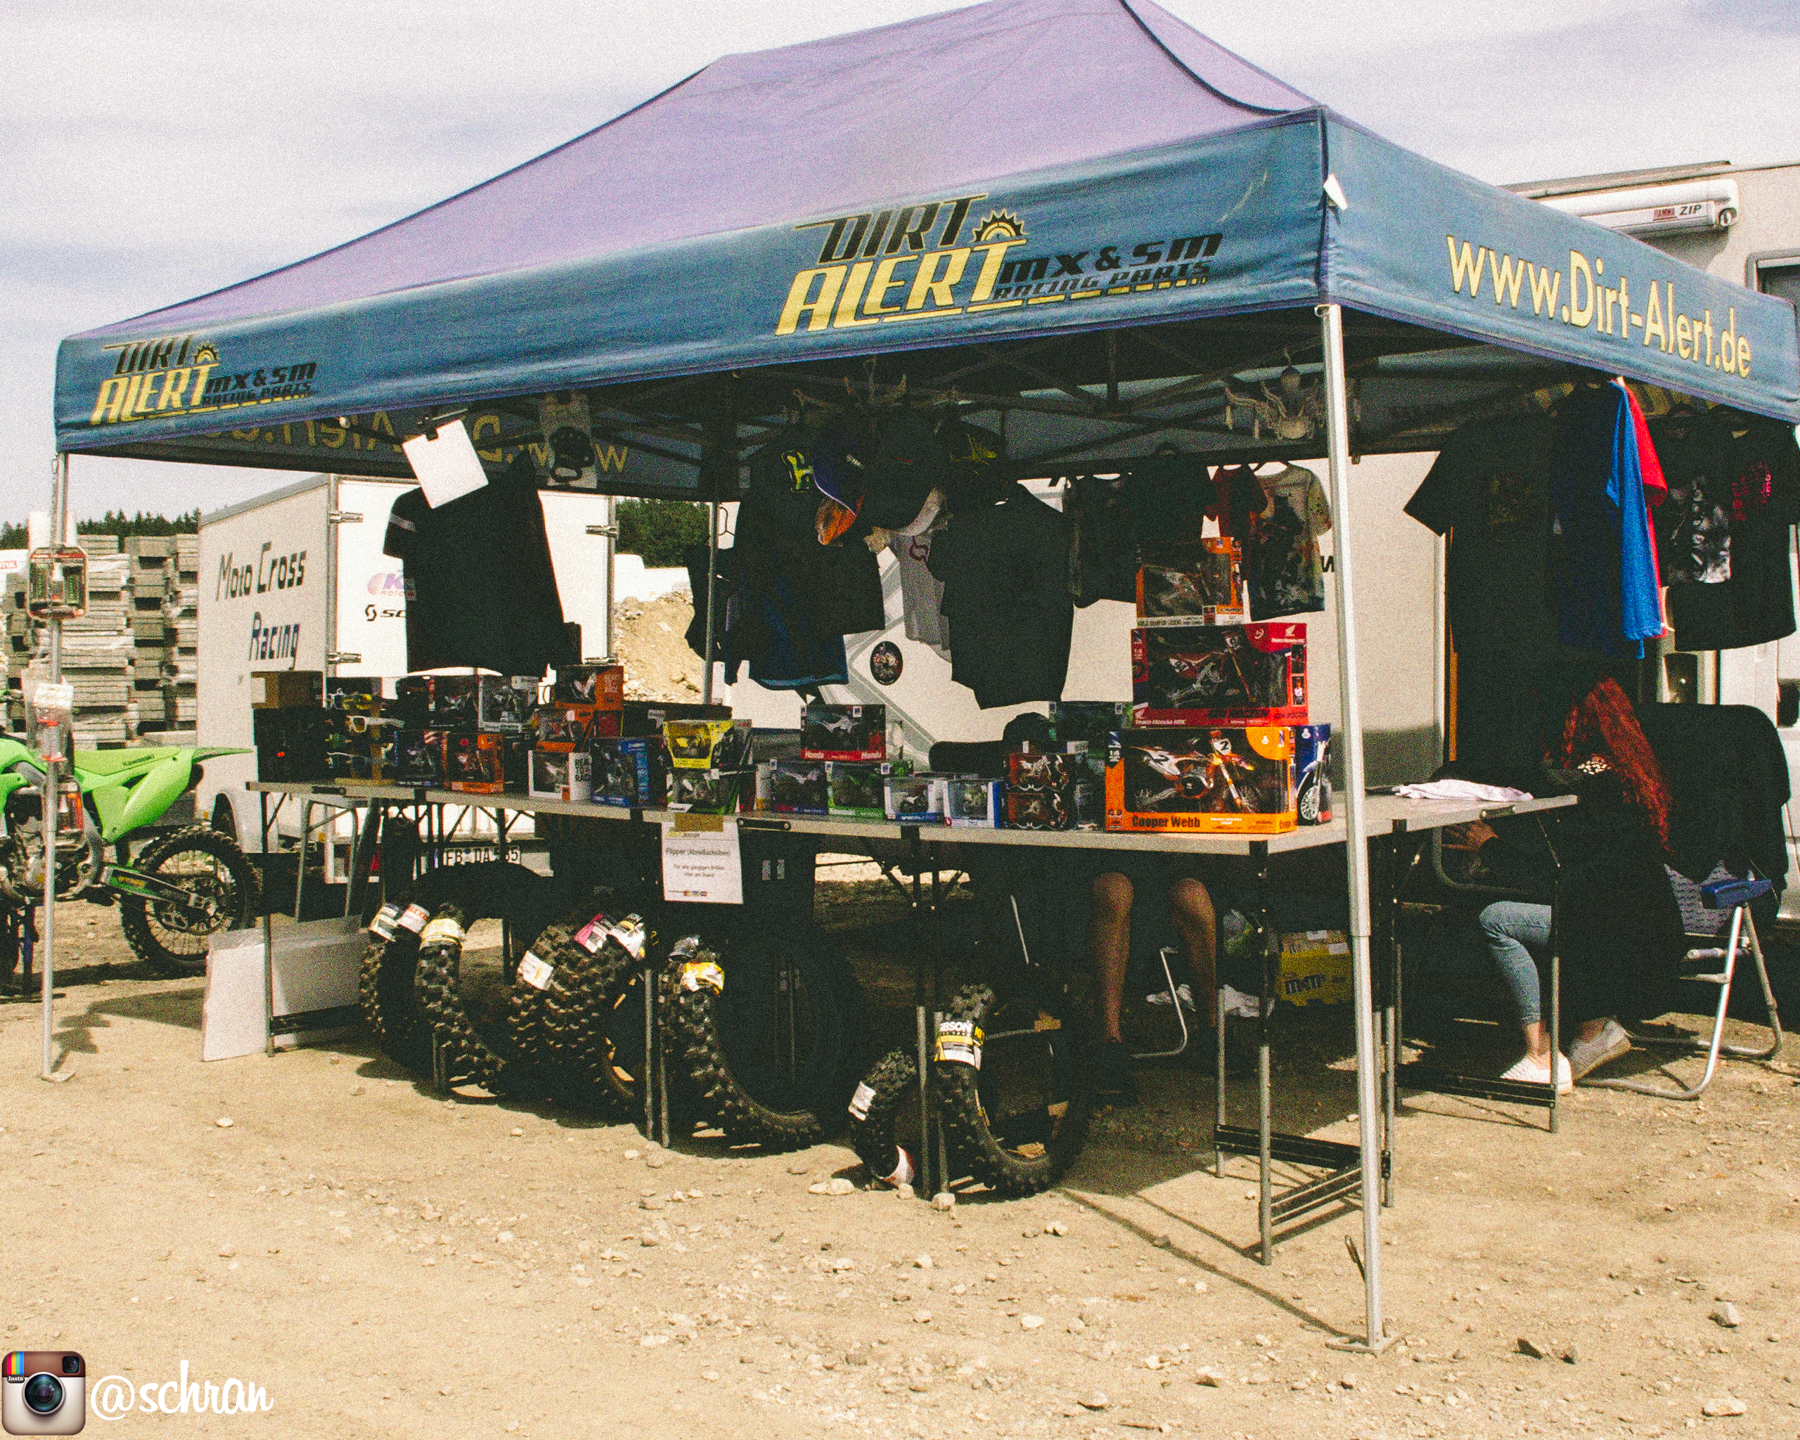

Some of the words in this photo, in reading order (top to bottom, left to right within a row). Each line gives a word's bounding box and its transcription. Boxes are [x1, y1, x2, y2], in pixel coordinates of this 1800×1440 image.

[794, 193, 989, 263] DIRT
[1679, 204, 1702, 216] ZIP
[774, 238, 1028, 336] ALERT
[992, 276, 1100, 301] RACING
[1109, 260, 1213, 286] PARTS
[104, 333, 195, 376] DIRT
[89, 362, 220, 426] ALERT
[217, 551, 254, 602] Moto
[257, 540, 307, 594] Cross
[249, 611, 300, 672] Racing
[1131, 815, 1169, 829] Cooper
[1170, 815, 1200, 828] Webb
